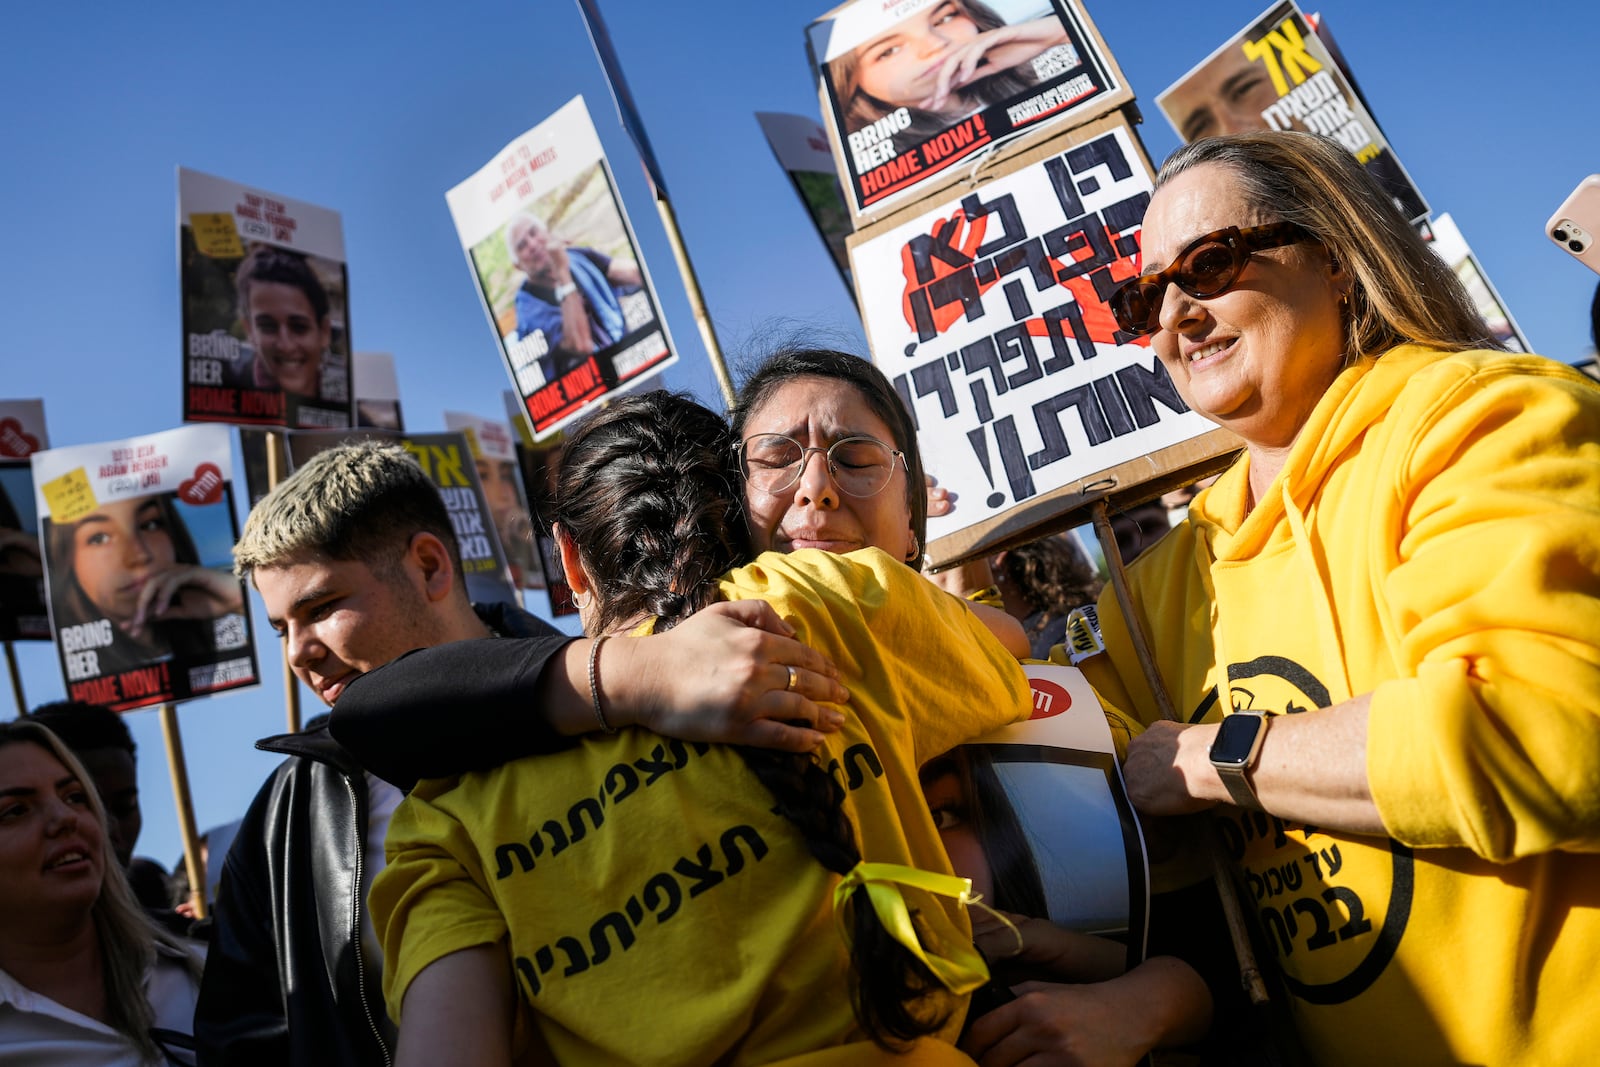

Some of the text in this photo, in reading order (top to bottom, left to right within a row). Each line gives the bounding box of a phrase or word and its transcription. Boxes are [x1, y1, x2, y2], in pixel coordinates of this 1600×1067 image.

[1242, 17, 1323, 98] אל
[1008, 78, 1095, 125] FAMILIES FORUM
[847, 107, 911, 155] BRING
[853, 139, 897, 176] HER
[859, 113, 988, 197] HOME NOW!
[908, 133, 1133, 286] הן לא
[188, 332, 240, 360] BRING
[189, 359, 223, 385] HER
[525, 355, 603, 421] HOME NOW!
[188, 386, 237, 413] HOME
[240, 390, 286, 418] NOW!
[402, 440, 472, 487] אל
[60, 618, 113, 653] BRING
[66, 650, 101, 681] HER
[70, 672, 122, 703] HOME
[124, 661, 171, 697] NOW!
[1304, 843, 1343, 881] עד
[1260, 886, 1372, 958] בבית
